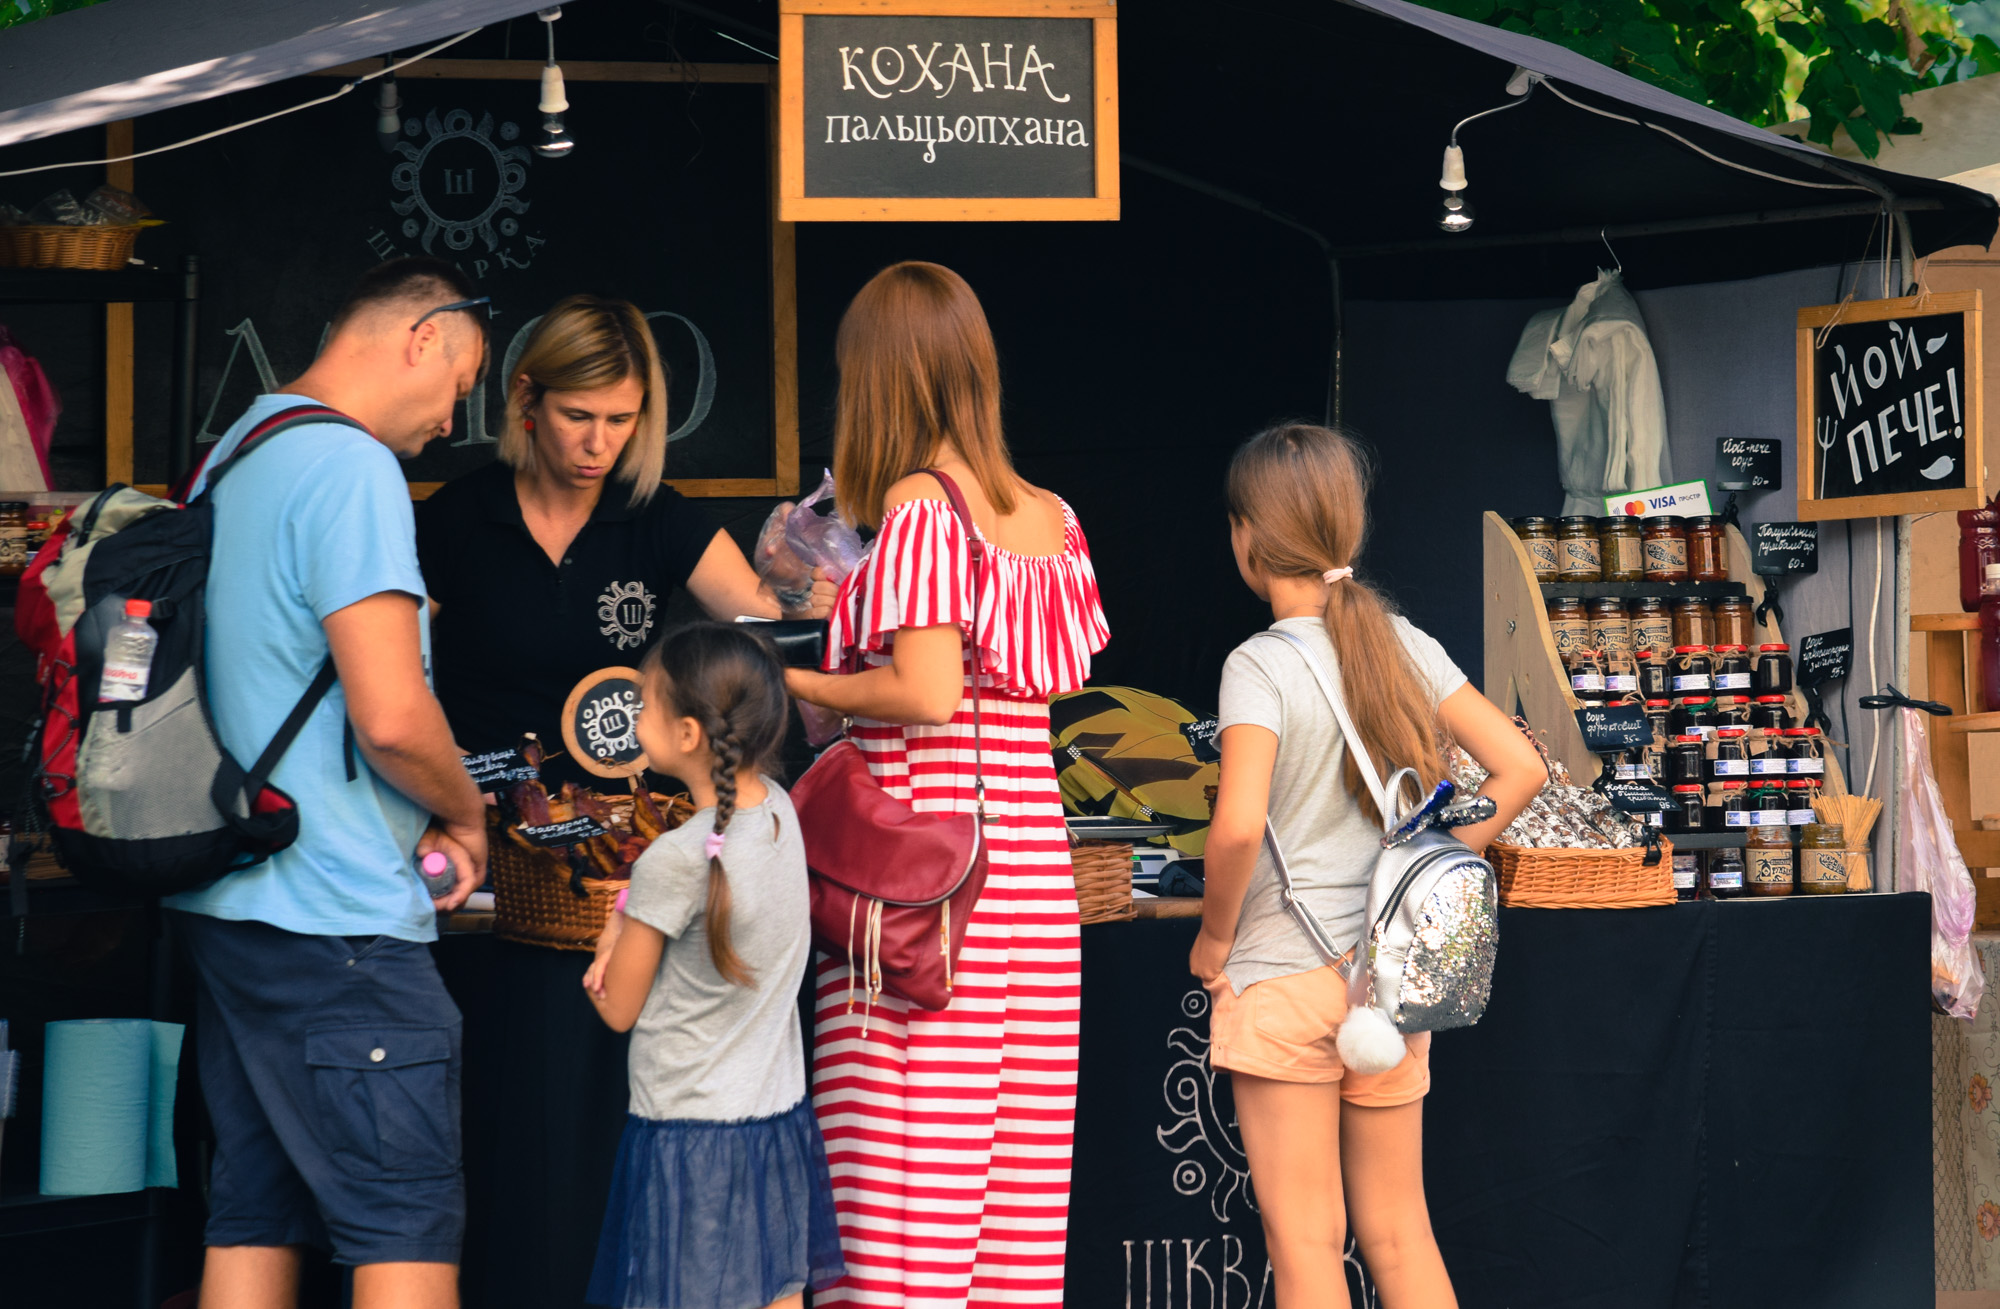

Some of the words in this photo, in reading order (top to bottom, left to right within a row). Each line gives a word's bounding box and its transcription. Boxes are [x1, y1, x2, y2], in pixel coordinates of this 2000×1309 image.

[839, 42, 1070, 102] КОХАНА
[825, 115, 1089, 163] пальцьопхана
[1830, 321, 1922, 419] ЙОЙ
[1847, 367, 1963, 484] ПЕЧЕ!
[1648, 495, 1677, 510] VISA
[622, 604, 642, 625] Ш
